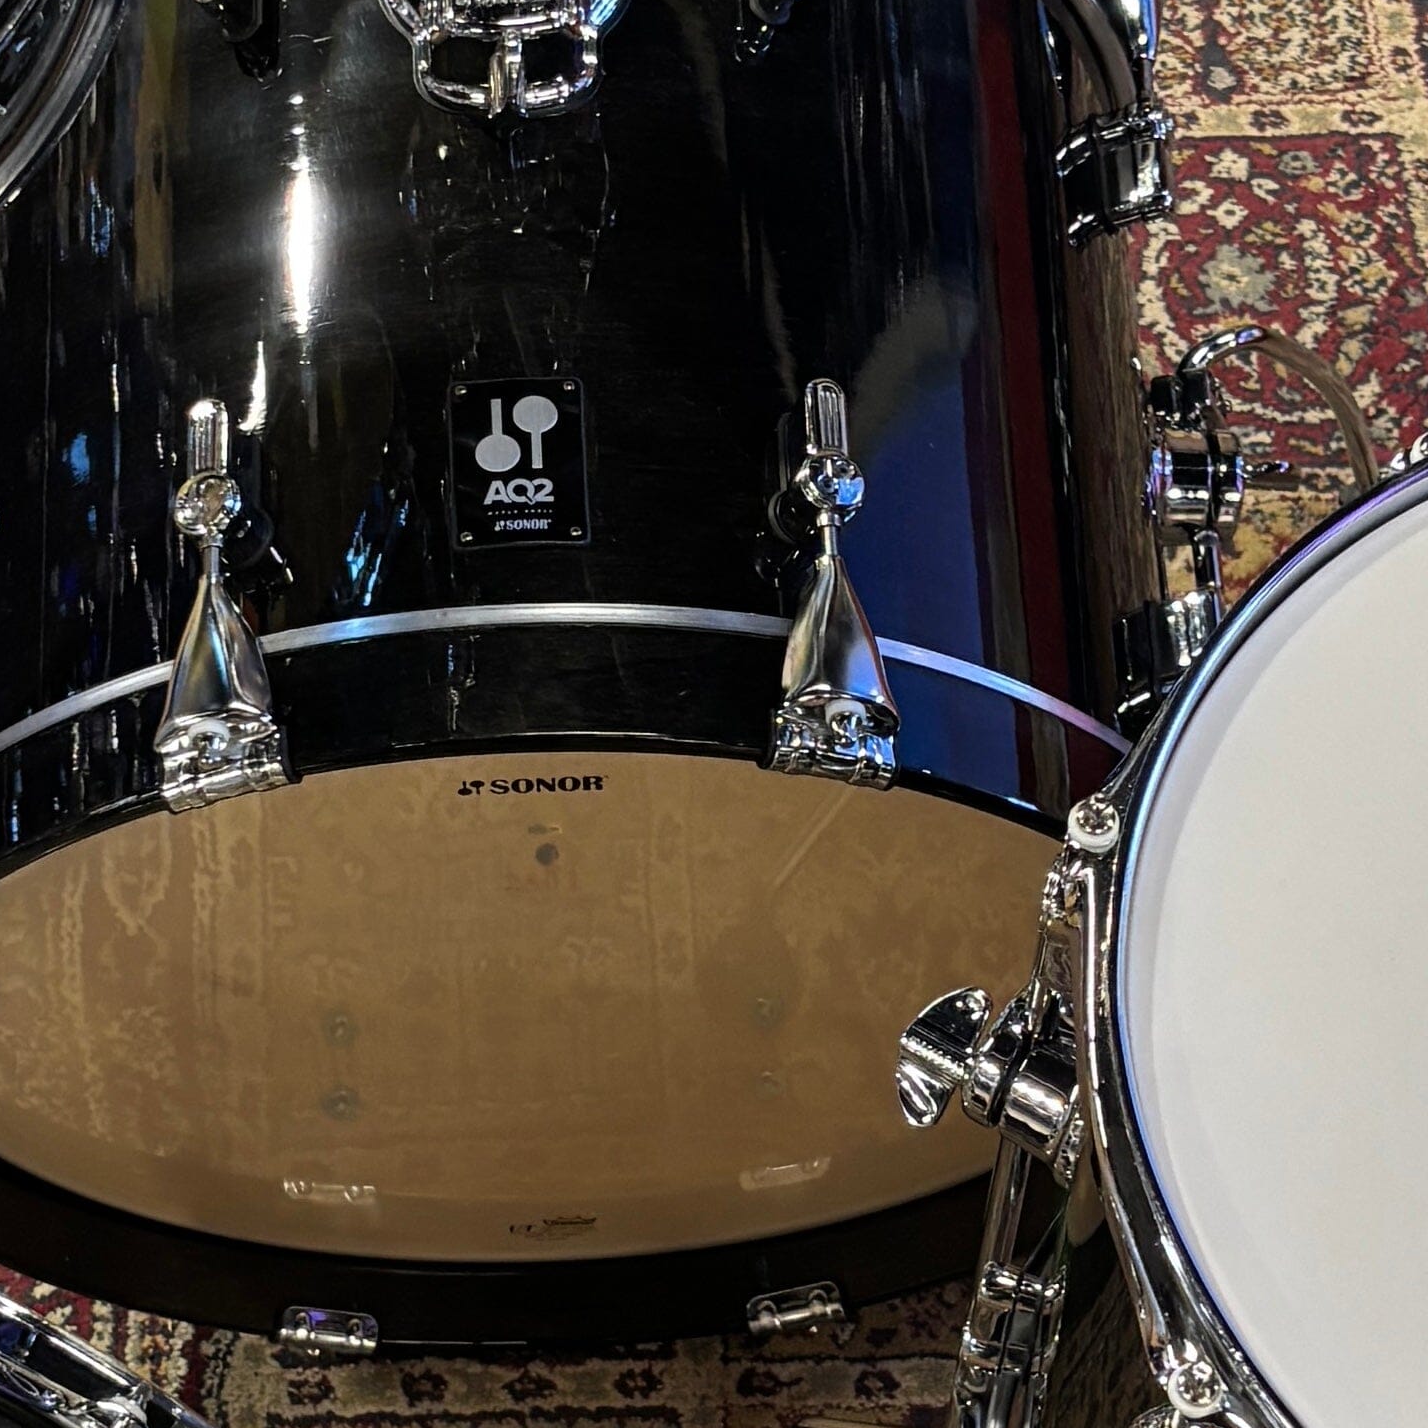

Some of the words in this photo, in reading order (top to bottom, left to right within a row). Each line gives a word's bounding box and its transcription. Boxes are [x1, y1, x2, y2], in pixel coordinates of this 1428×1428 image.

[483, 478, 554, 505] AQ2
[506, 519, 548, 530] SONOR
[489, 775, 604, 794] SONOR
